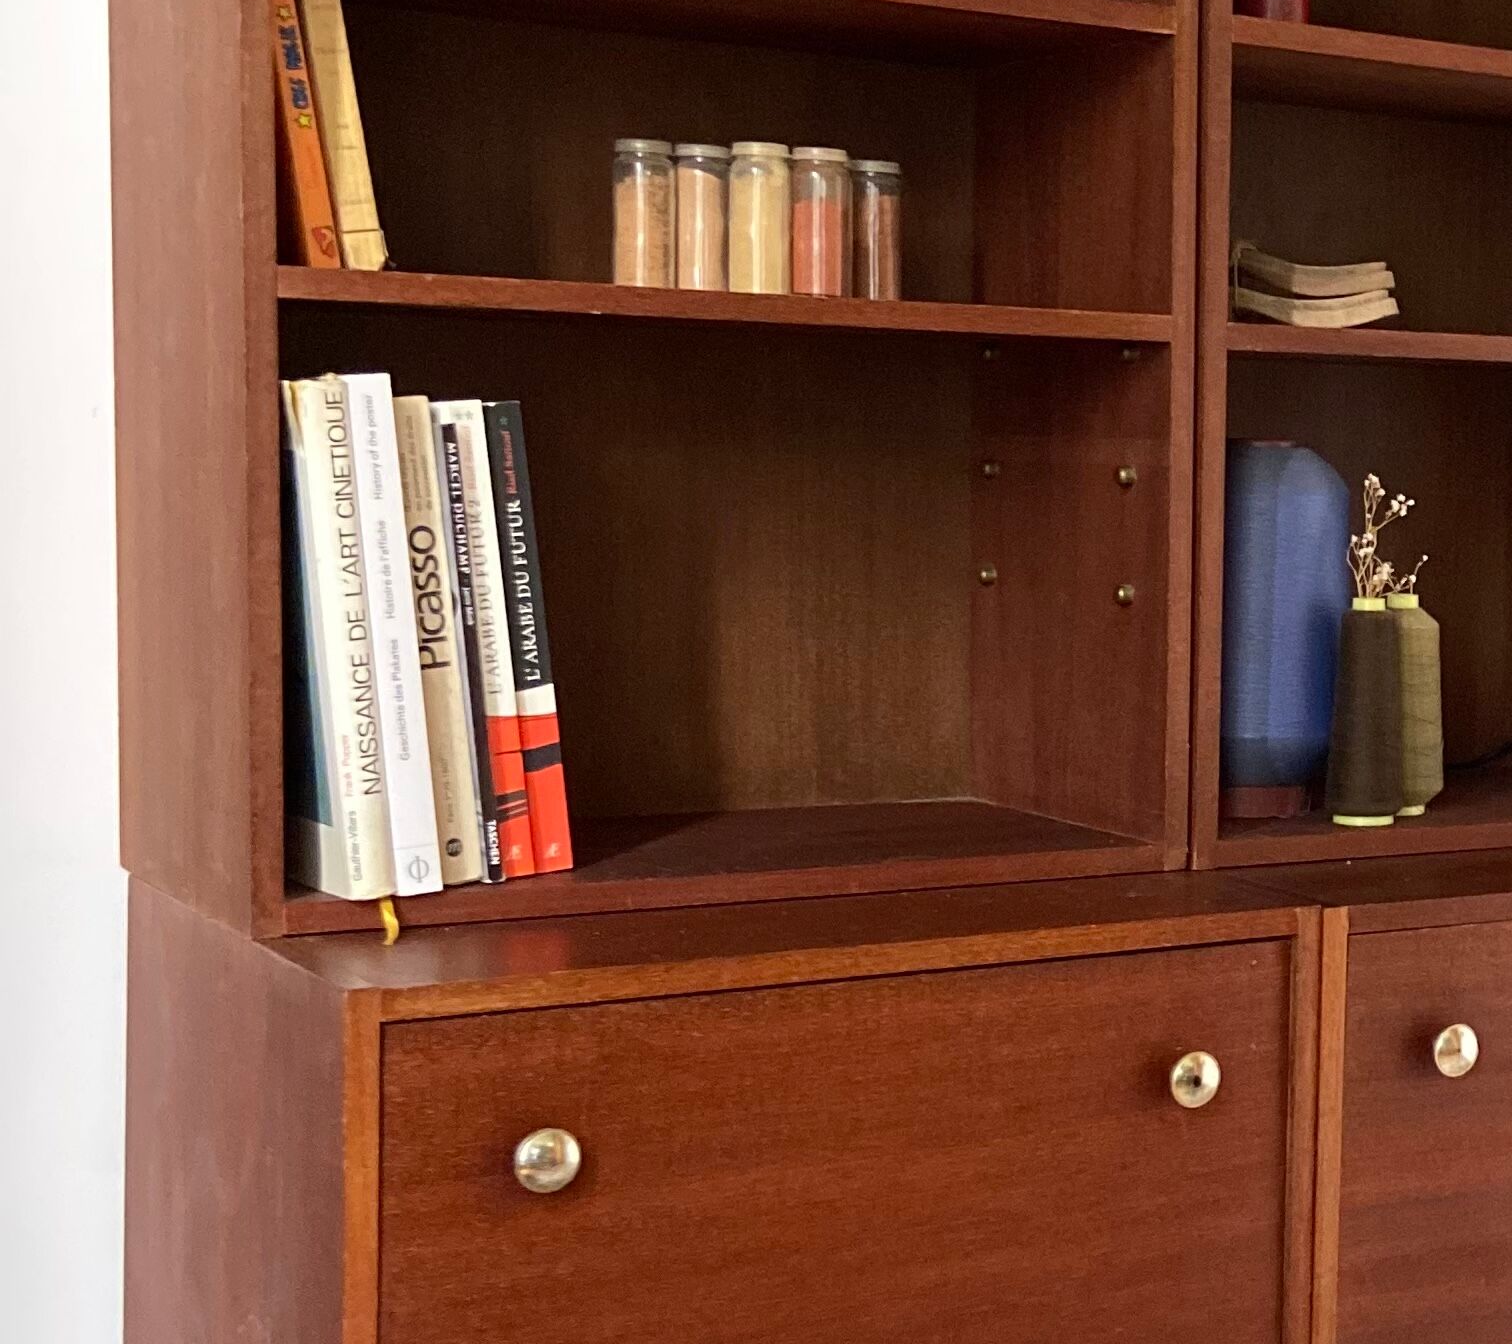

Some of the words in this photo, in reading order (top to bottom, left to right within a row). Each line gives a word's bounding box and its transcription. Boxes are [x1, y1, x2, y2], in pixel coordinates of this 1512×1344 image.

[362, 393, 378, 428] poster
[324, 390, 355, 520] CINETIQUE
[364, 429, 378, 447] the
[367, 449, 380, 461] of
[368, 462, 384, 500] History
[446, 441, 465, 496] MARCEL
[468, 498, 481, 510] 2
[375, 519, 390, 562] l'affiche
[451, 502, 473, 575] DUCHAMP
[469, 509, 489, 577] FUTUR
[505, 498, 529, 566] FUTUR
[338, 527, 363, 598] L'ART
[379, 563, 392, 578] de
[380, 579, 396, 620] Histoire
[408, 524, 452, 671] Picasso
[475, 583, 492, 611] DU
[511, 570, 530, 599] DU
[345, 610, 368, 642] DE
[388, 638, 402, 682] Plakates
[392, 683, 405, 703] des
[351, 653, 382, 796] NAISSANCE
[395, 704, 411, 762] Geschichte
[339, 734, 351, 767] Popper
[341, 771, 355, 798] Frank
[485, 819, 501, 866] TASCHEN
